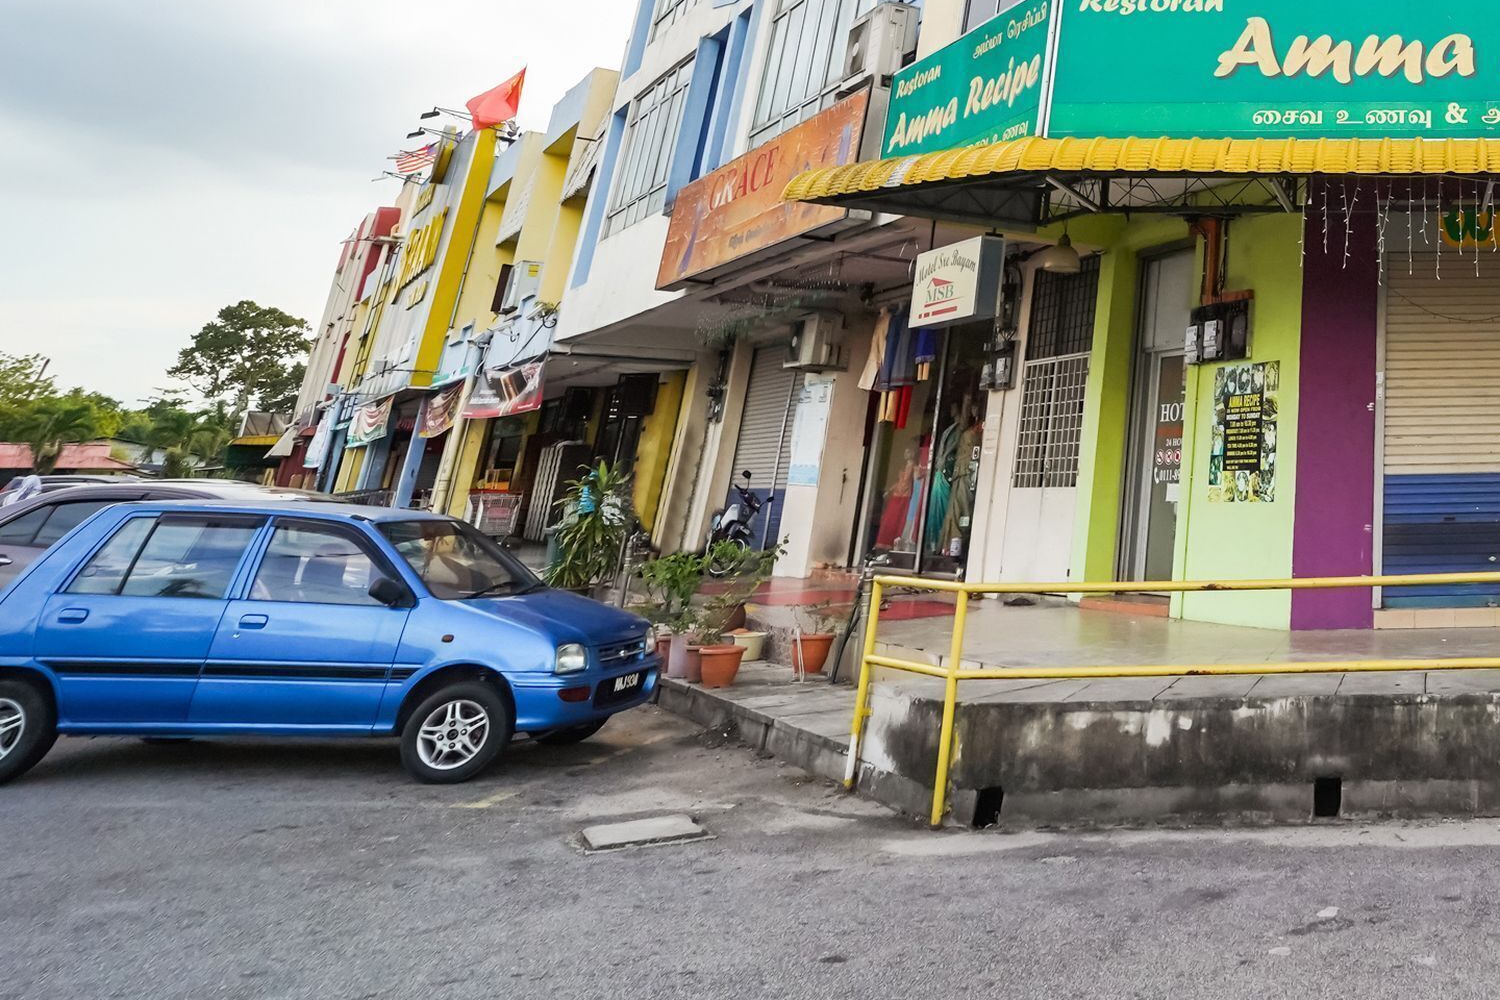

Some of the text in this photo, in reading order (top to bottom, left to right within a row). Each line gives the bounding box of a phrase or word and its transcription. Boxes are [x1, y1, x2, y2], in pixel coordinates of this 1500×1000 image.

[1214, 16, 1476, 84] Amma
[895, 65, 942, 99] Restoran
[887, 53, 1042, 153] Amma Recipe
[1252, 107, 1323, 126] சைவ
[1336, 109, 1432, 129] உணவு
[1445, 102, 1468, 124] &
[708, 145, 780, 212] GRACE
[916, 254, 938, 287] Motel
[951, 248, 976, 273] Bayam
[926, 284, 954, 303] MSB
[1244, 393, 1261, 406] RECIPE
